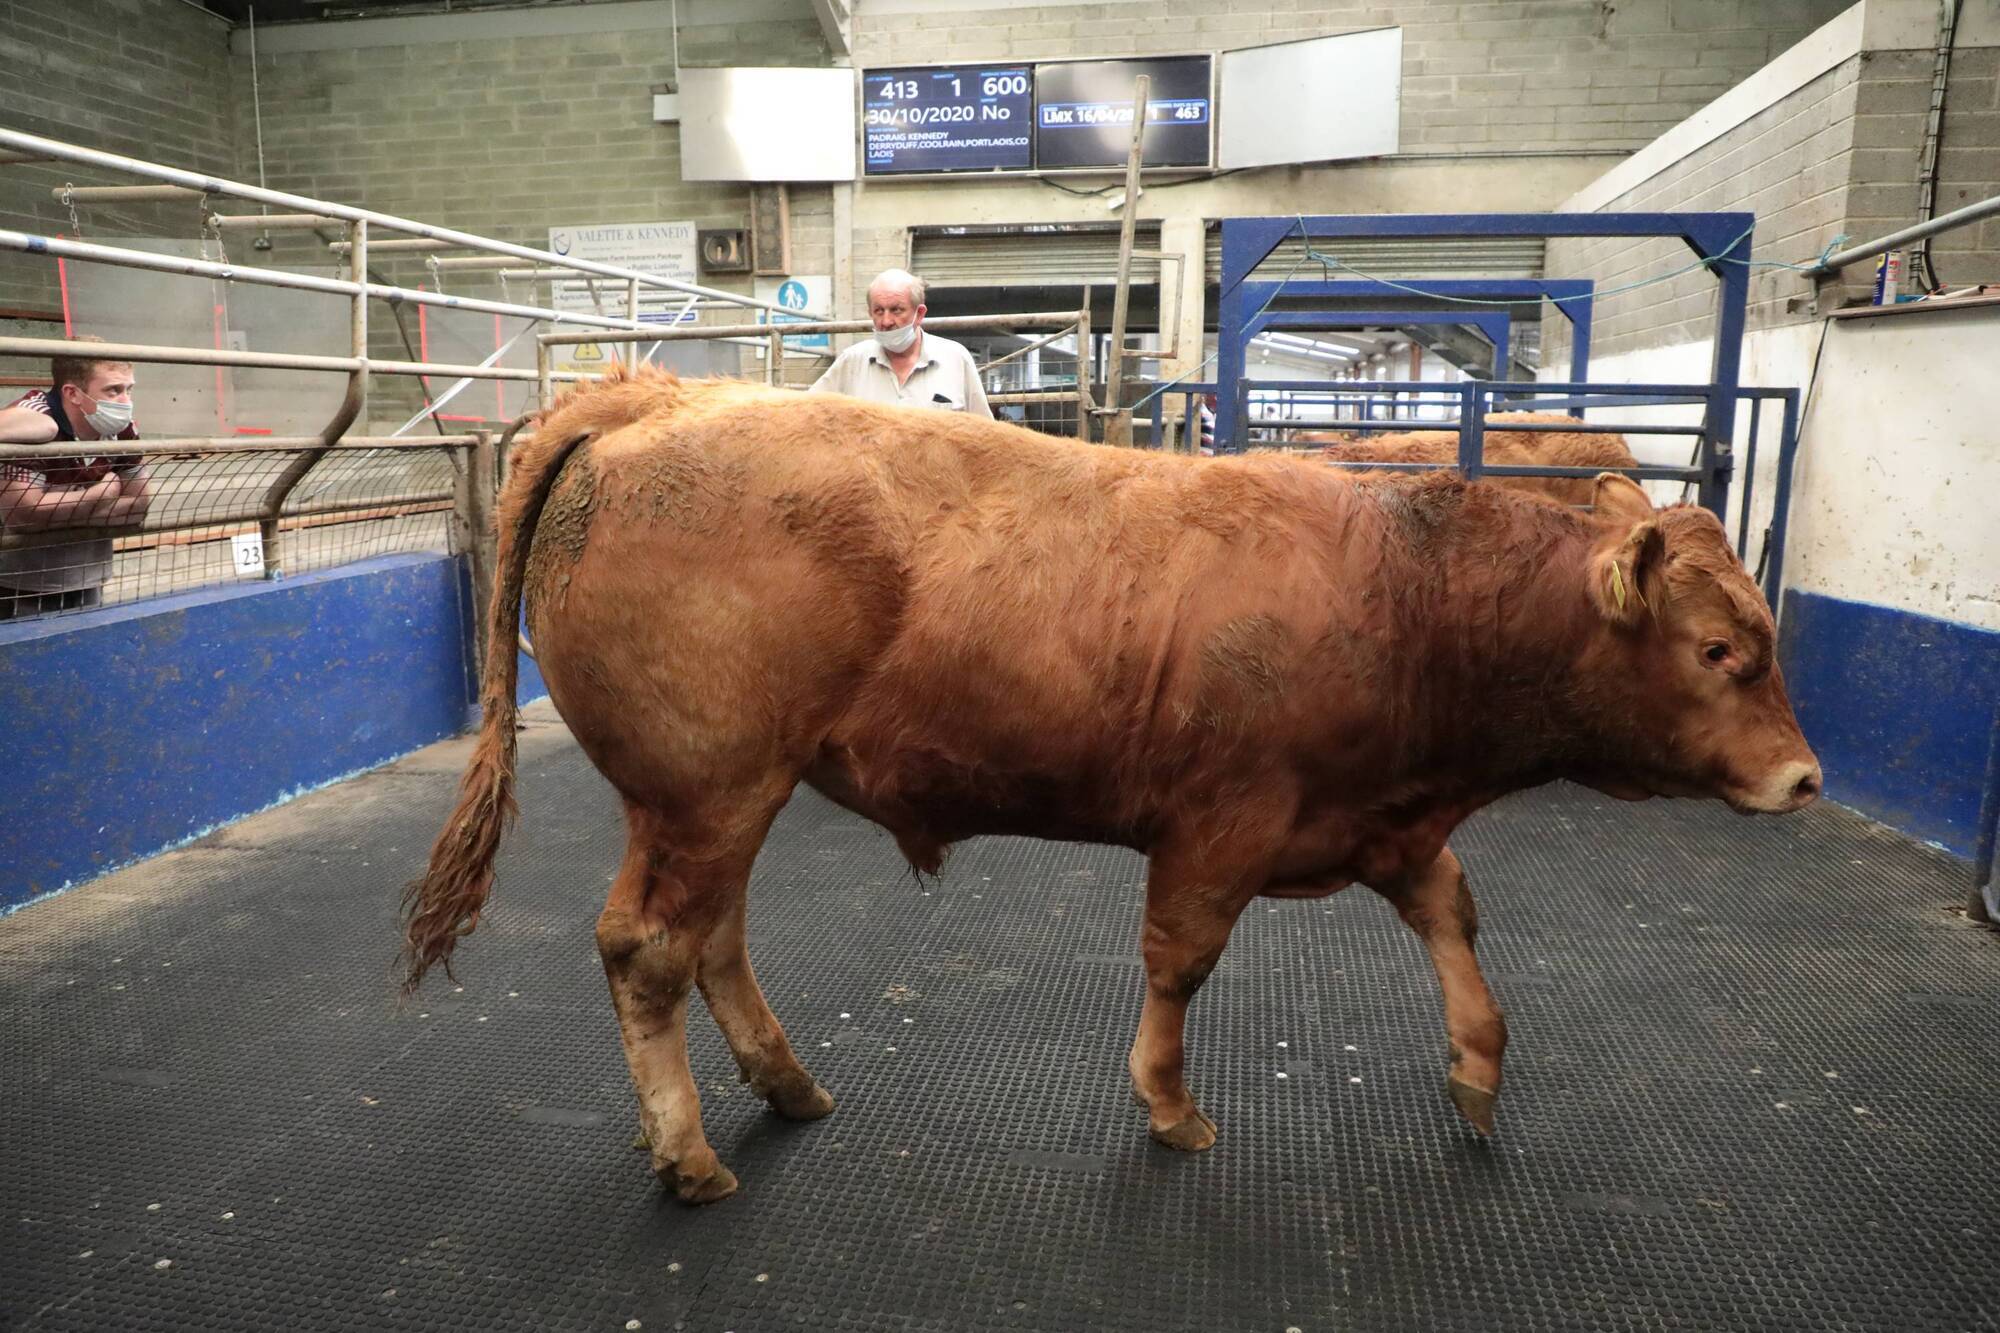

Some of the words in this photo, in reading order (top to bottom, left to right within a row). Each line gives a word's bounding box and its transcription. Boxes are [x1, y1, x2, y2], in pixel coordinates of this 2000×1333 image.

[880, 81, 919, 99] 413
[951, 79, 961, 97] 1
[983, 76, 1027, 96] 600
[868, 105, 975, 125] 30/10/2020
[982, 105, 1011, 120] No
[1043, 110, 1073, 123] LMX
[1175, 106, 1200, 119] 463
[868, 133, 906, 142] PADRAIG
[908, 131, 949, 140] KENNEDY
[868, 150, 894, 158] LAOIS
[576, 229, 625, 242] VALETTE
[626, 229, 635, 240] &
[638, 226, 689, 240] KENNEDY
[242, 546, 260, 566] 23
